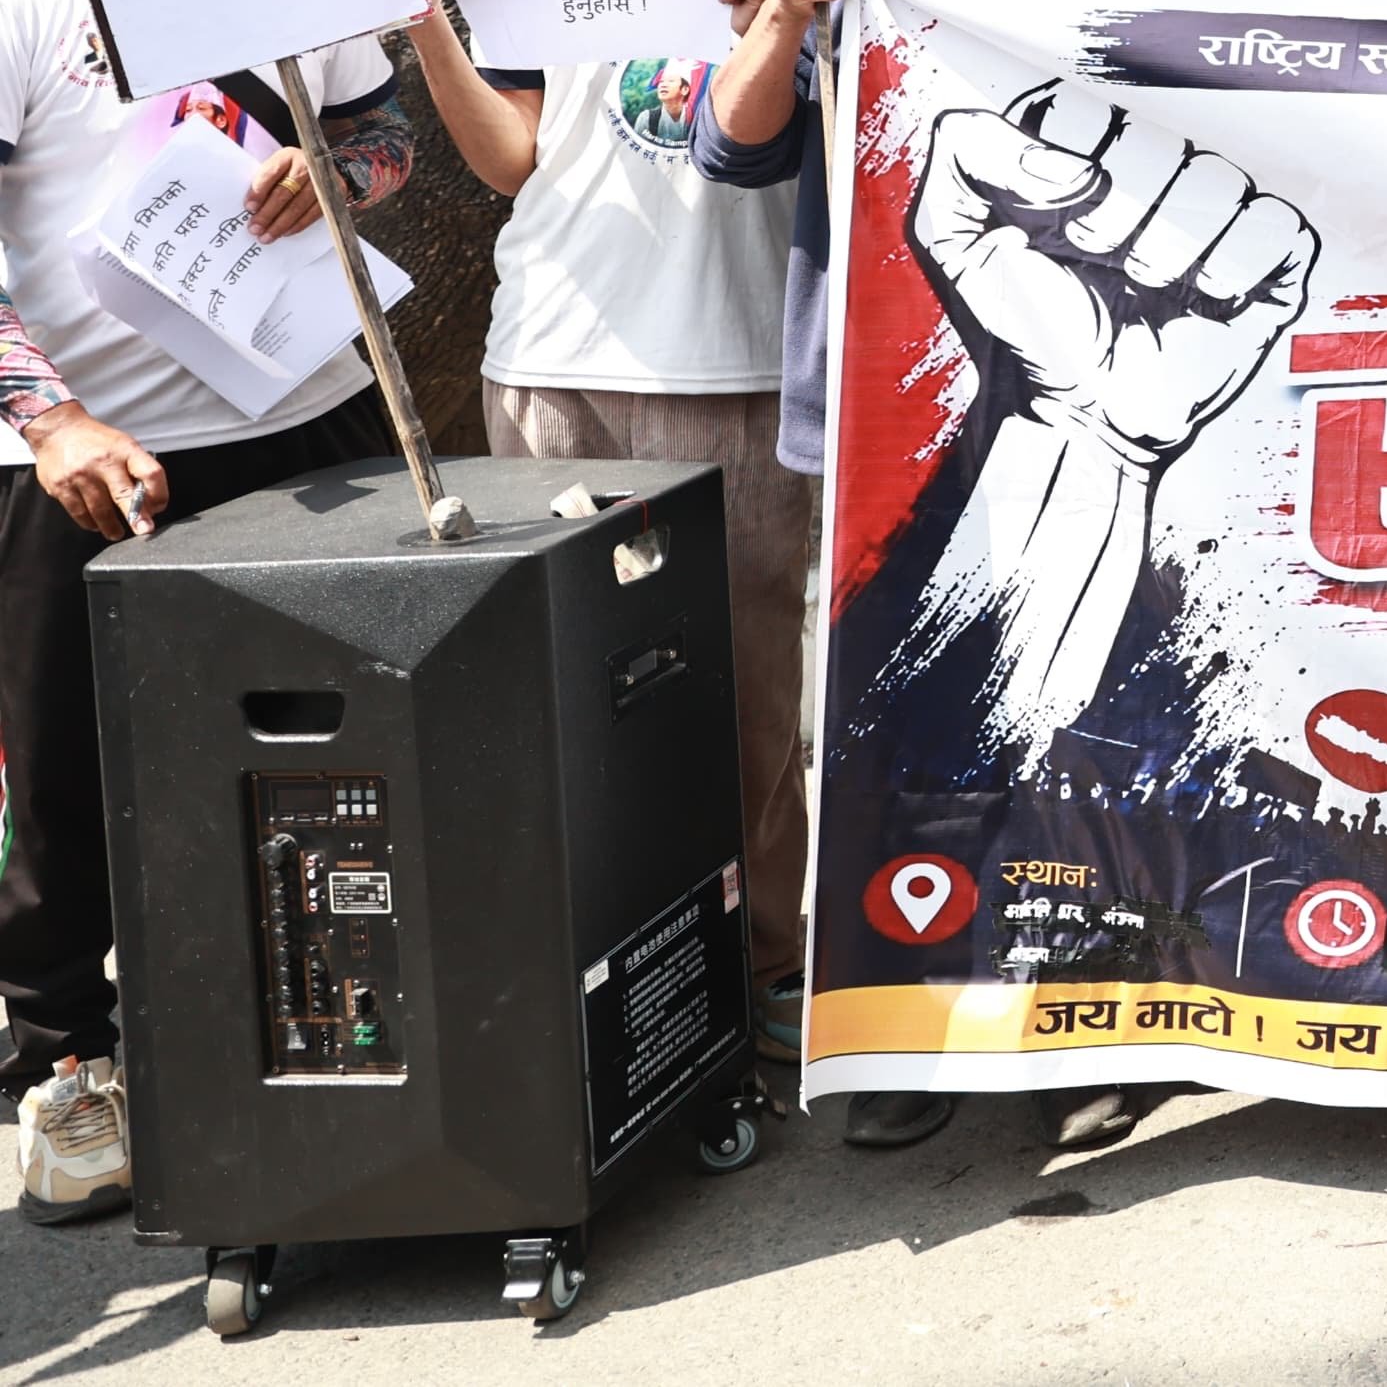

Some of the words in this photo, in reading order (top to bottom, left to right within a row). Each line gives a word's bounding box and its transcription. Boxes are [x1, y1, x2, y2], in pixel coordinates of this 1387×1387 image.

[1199, 30, 1343, 76] राष्ट्रिय
[1034, 1000, 1122, 1036] जय
[1135, 995, 1235, 1038] माटो
[1256, 1014, 1264, 1043] !
[1295, 1020, 1382, 1056] जय
